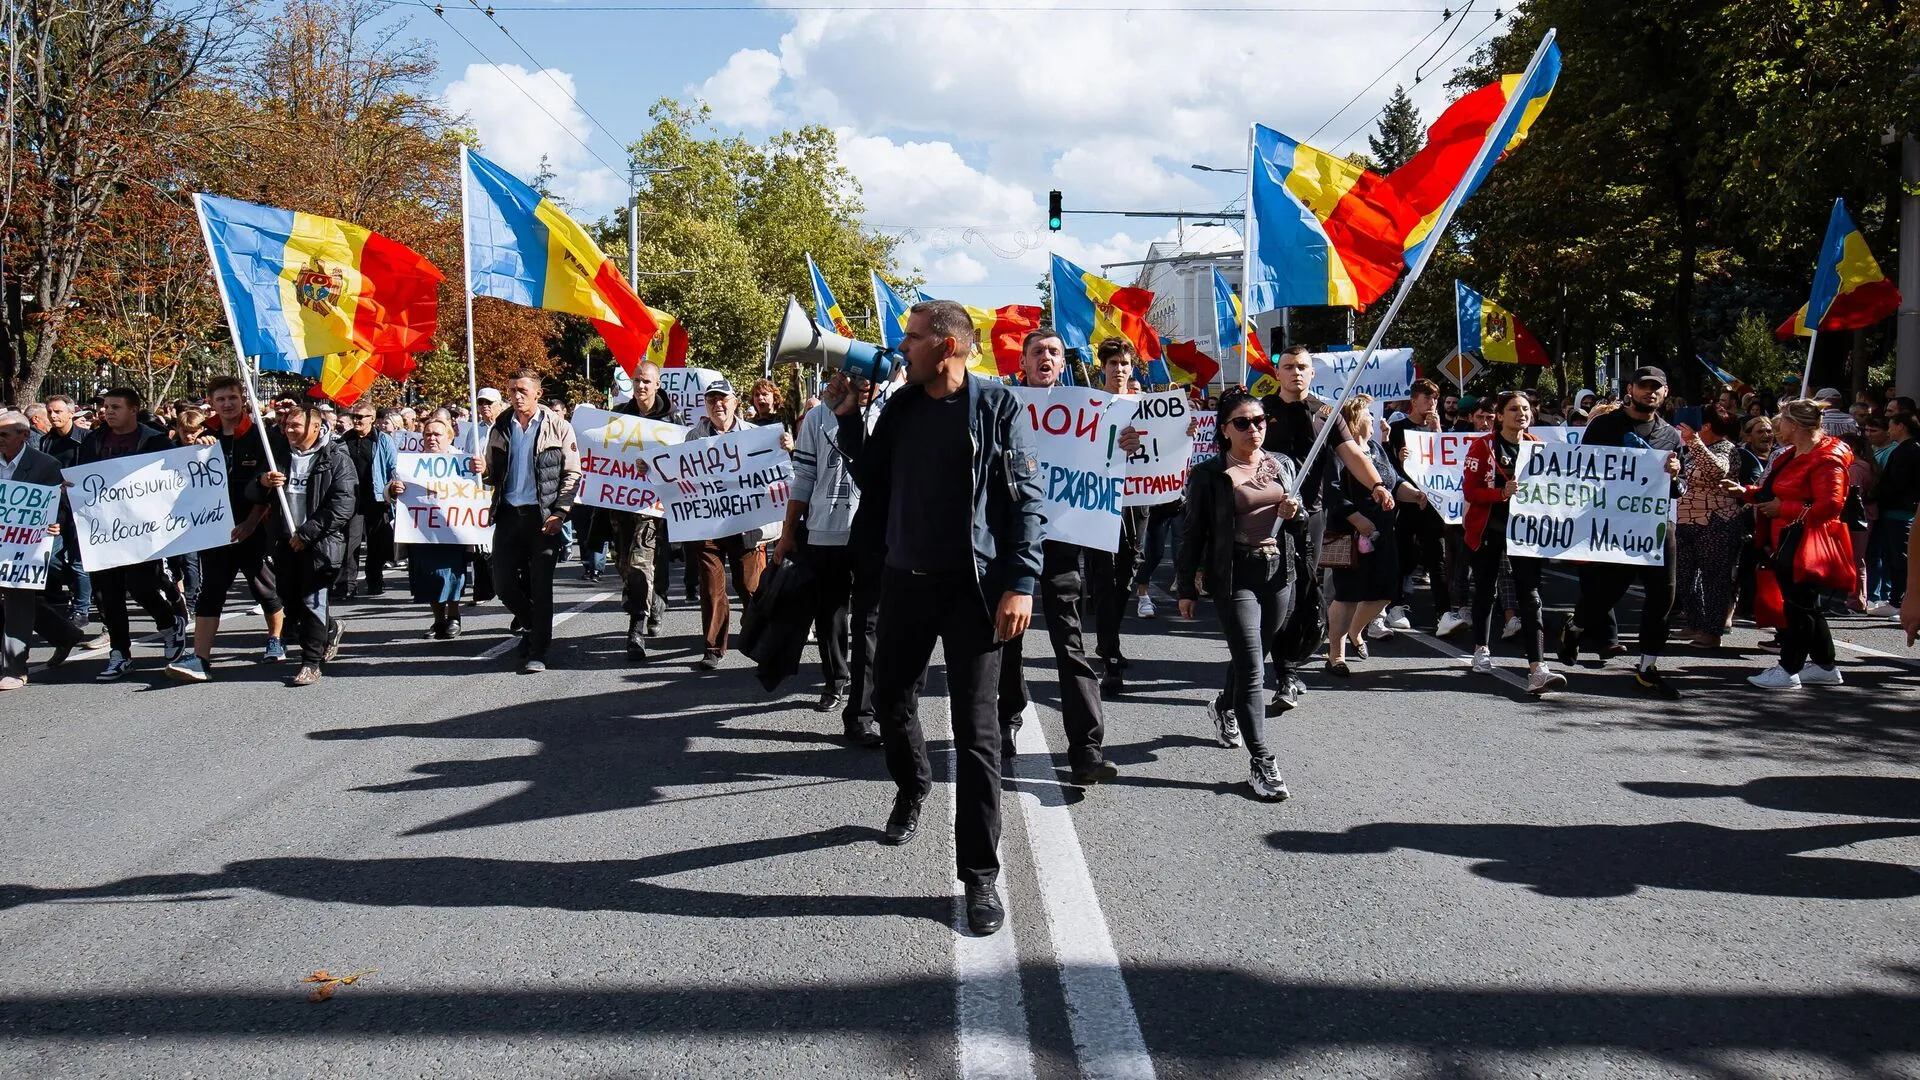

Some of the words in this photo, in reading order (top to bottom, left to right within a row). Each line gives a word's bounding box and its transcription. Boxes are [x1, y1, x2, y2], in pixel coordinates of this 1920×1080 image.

[652, 443, 741, 483] САНДУ
[1528, 443, 1649, 486] БАЙДЕН,
[700, 479, 727, 496] НЕ
[1516, 483, 1606, 509] ЗАБЕРИ
[1616, 495, 1668, 516] СЕБЕ
[671, 493, 766, 522] ПРЕЗИДЕНТ
[1510, 513, 1574, 549] СВОЮ
